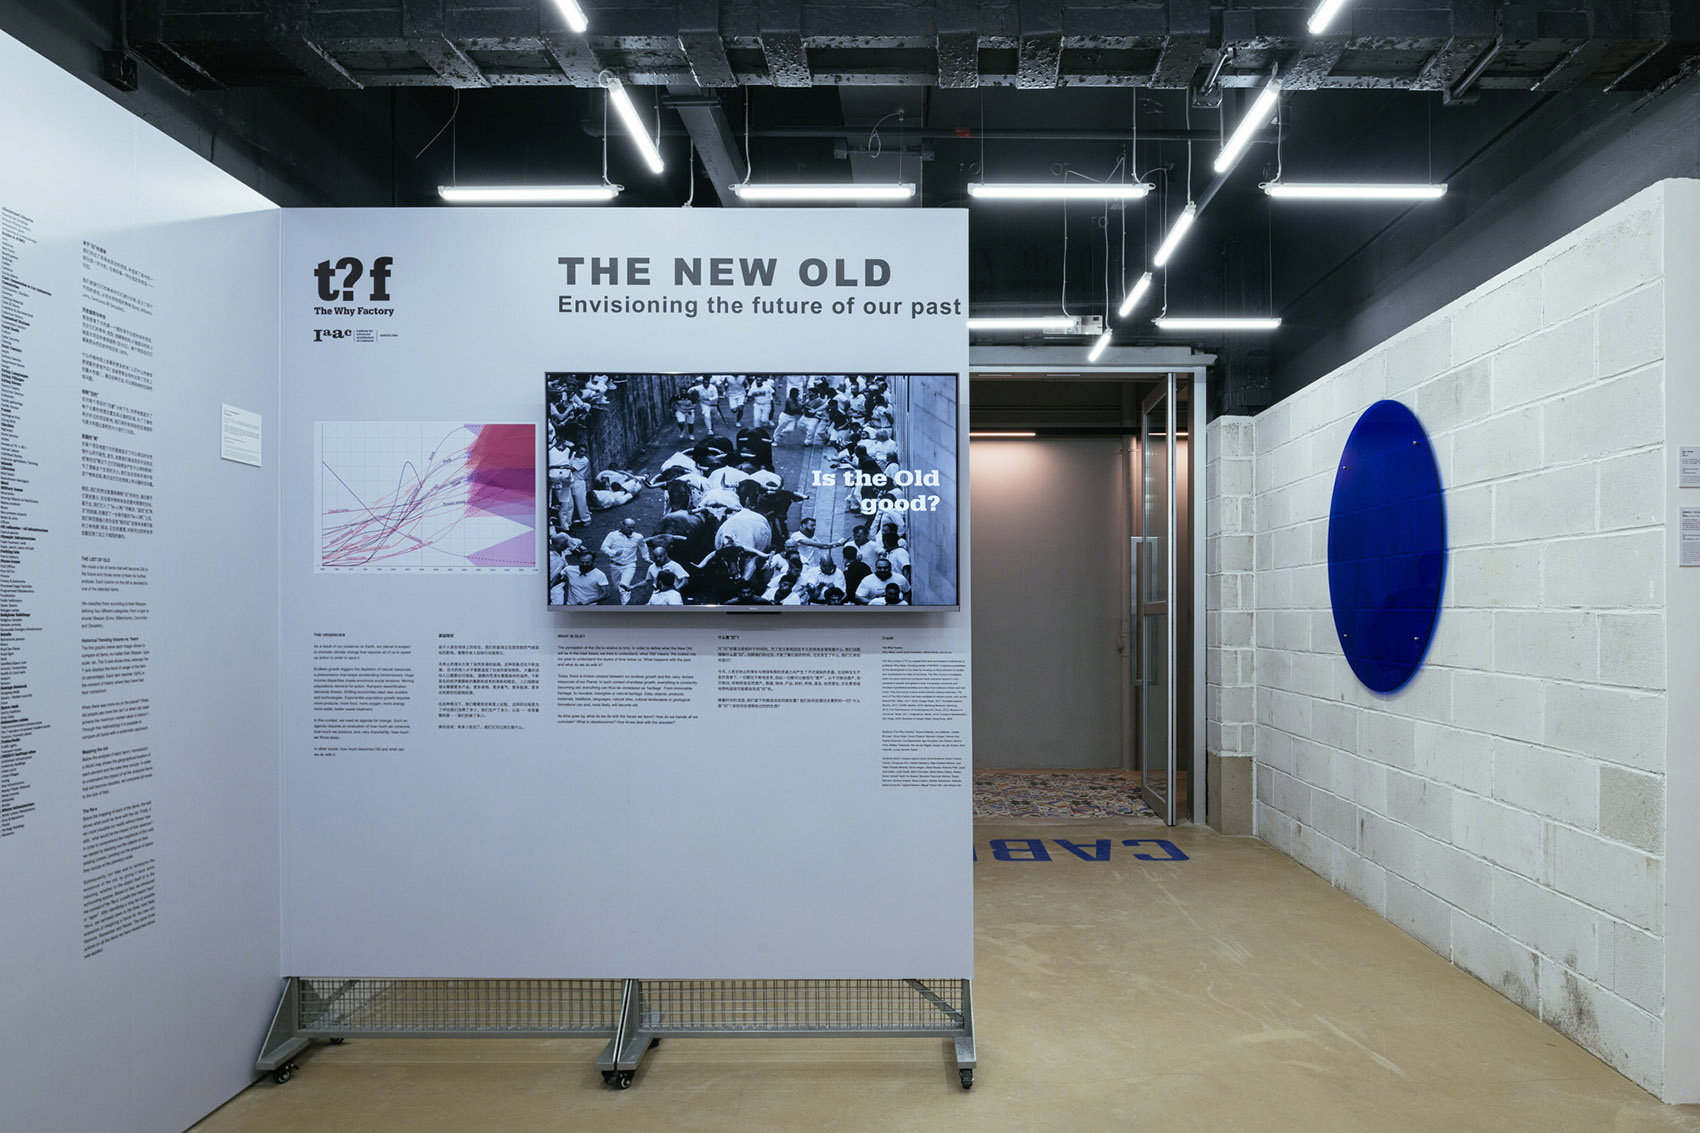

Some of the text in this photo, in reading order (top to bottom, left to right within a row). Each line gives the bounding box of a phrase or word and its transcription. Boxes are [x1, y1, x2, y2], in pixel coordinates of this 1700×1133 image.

[558, 257, 890, 286] THE NEW OLD
[314, 307, 394, 317] The Why Factory
[559, 296, 960, 318] Envisioning the future of our past
[812, 470, 940, 487] Is the Old
[862, 495, 940, 515] good?
[974, 839, 1190, 861] CAB
